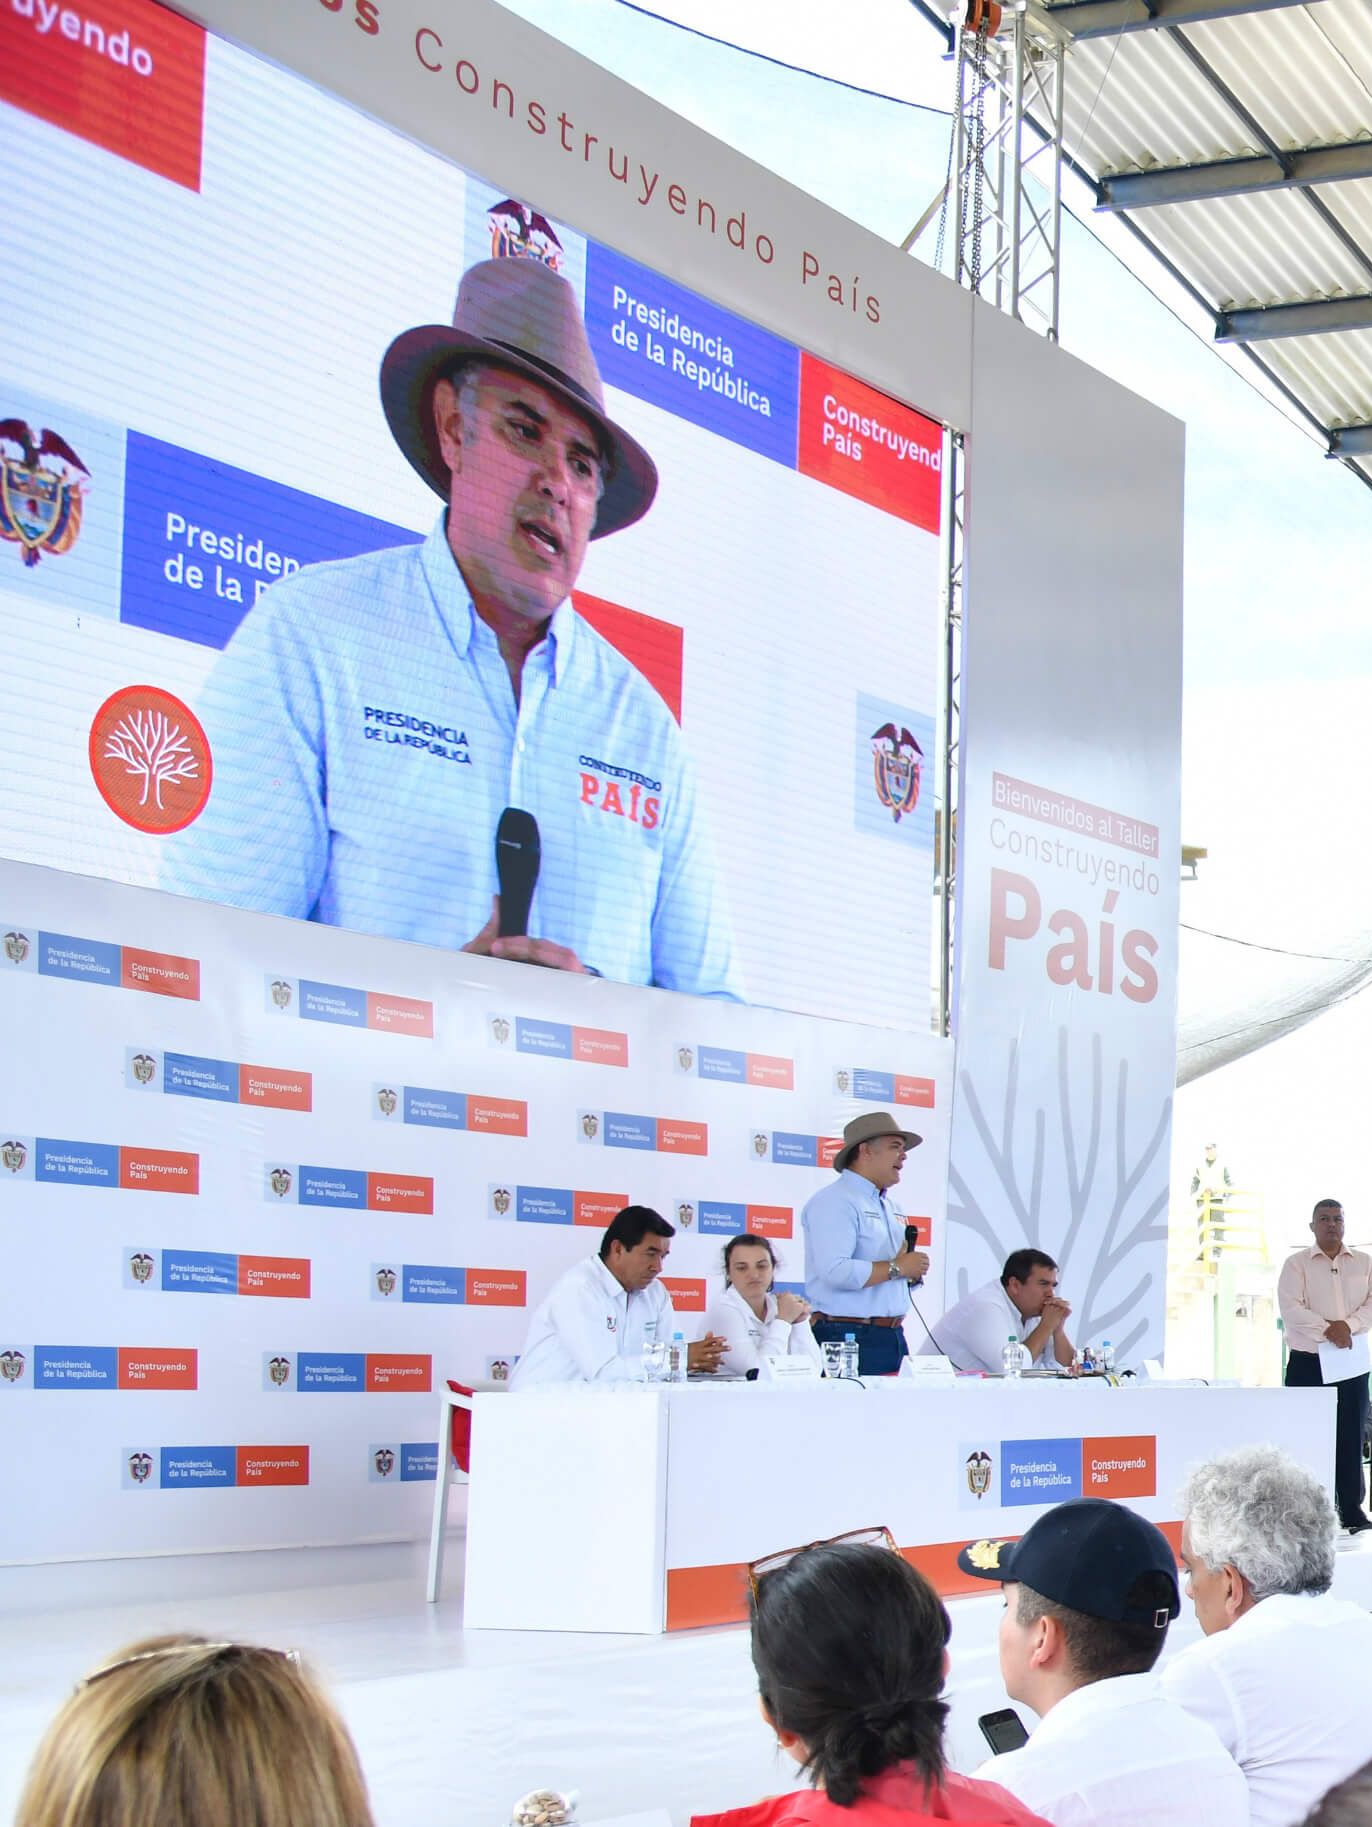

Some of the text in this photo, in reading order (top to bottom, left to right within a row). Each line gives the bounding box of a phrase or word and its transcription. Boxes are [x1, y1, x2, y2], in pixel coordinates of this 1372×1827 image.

[415, 28, 881, 323] Construyendo País
[612, 285, 734, 368] Presidencia
[611, 319, 772, 418] de la República
[823, 394, 942, 472] Construyend
[822, 422, 863, 462] País
[166, 511, 299, 576] Presiden
[164, 553, 204, 590] de
[215, 565, 244, 603] la
[363, 706, 469, 747] PRESIDENCIA
[364, 726, 383, 742] DE
[579, 772, 660, 830] PAÍS
[994, 780, 1158, 852] Bienvenidos al Taller
[989, 817, 1160, 896] Construyendo
[988, 866, 1160, 1004] País
[48, 947, 95, 963] Presidencia
[48, 956, 59, 966] de
[61, 958, 68, 967] la
[132, 962, 189, 981] Construyendo
[172, 1067, 215, 1080] Presidencia
[172, 1076, 182, 1084] de
[183, 1077, 190, 1085] la
[248, 1078, 302, 1093] Construyendo
[45, 1153, 92, 1166] Presidencia
[45, 1162, 108, 1177] de la República
[130, 1162, 188, 1176] Construyendo
[130, 1170, 147, 1180] País
[306, 1179, 346, 1190] Presidencia
[376, 1186, 424, 1198] Construyendo
[170, 1263, 214, 1274] Presidencia
[248, 1269, 301, 1281] Construyendo
[170, 1272, 180, 1280] de
[410, 1277, 446, 1286] Presidencia
[474, 1281, 518, 1290] Construyendo
[44, 1360, 91, 1369] Presidencia
[128, 1362, 186, 1372] Construyendo
[305, 1365, 344, 1374] Presidencia
[374, 1366, 422, 1375] Construyendo
[66, 1370, 107, 1380] República
[128, 1371, 146, 1379] País
[169, 1460, 212, 1470] Presidencia
[245, 1459, 299, 1469] Construyendo
[1010, 1461, 1057, 1475] Presidencia
[1091, 1457, 1146, 1472] Construyendo
[189, 1468, 226, 1479] República
[245, 1468, 262, 1476] País
[1091, 1472, 1108, 1483] País
[1010, 1473, 1072, 1490] de la República
